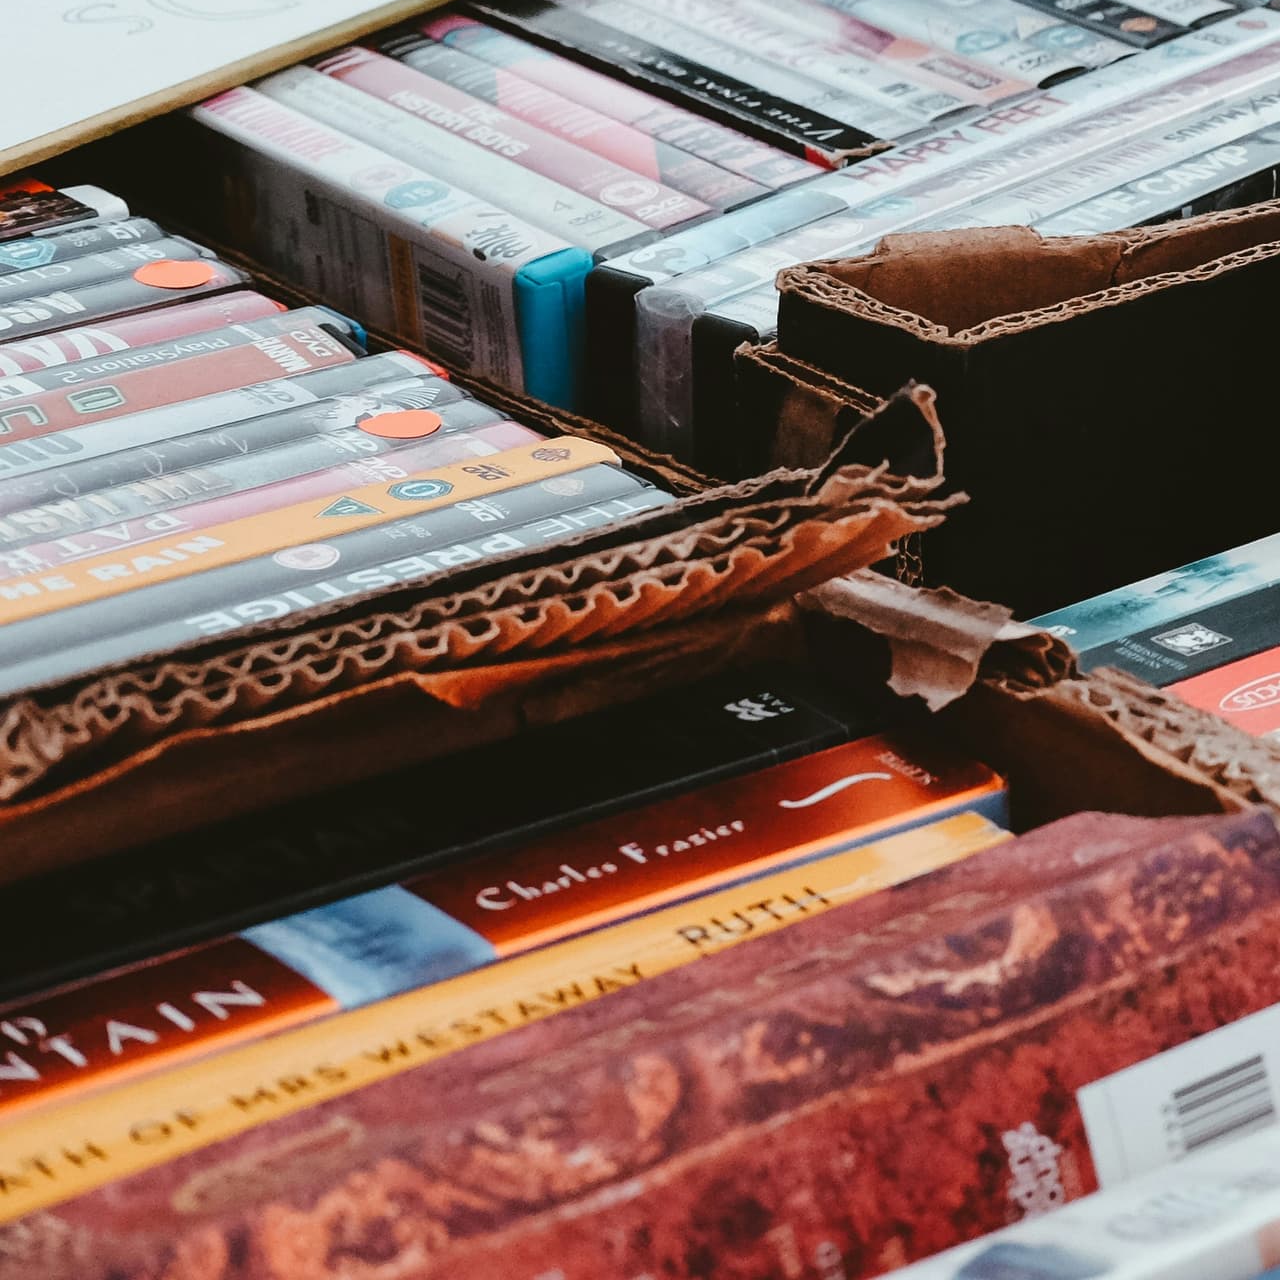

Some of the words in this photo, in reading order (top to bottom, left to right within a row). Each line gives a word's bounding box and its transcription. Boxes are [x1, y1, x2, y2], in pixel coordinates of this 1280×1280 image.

[468, 123, 530, 158] BOYS
[842, 129, 972, 184] HAPPY
[1135, 145, 1249, 199] CAMP
[541, 498, 651, 539] THE
[88, 535, 227, 582] RAIN
[183, 532, 526, 635] PRESTIGE
[474, 860, 620, 912] Charles
[617, 818, 745, 865] Frazier
[128, 1111, 199, 1147] OF
[228, 1064, 350, 1113] MRS
[363, 960, 648, 1069] WESTAWAY
[677, 884, 831, 950] RUTH
